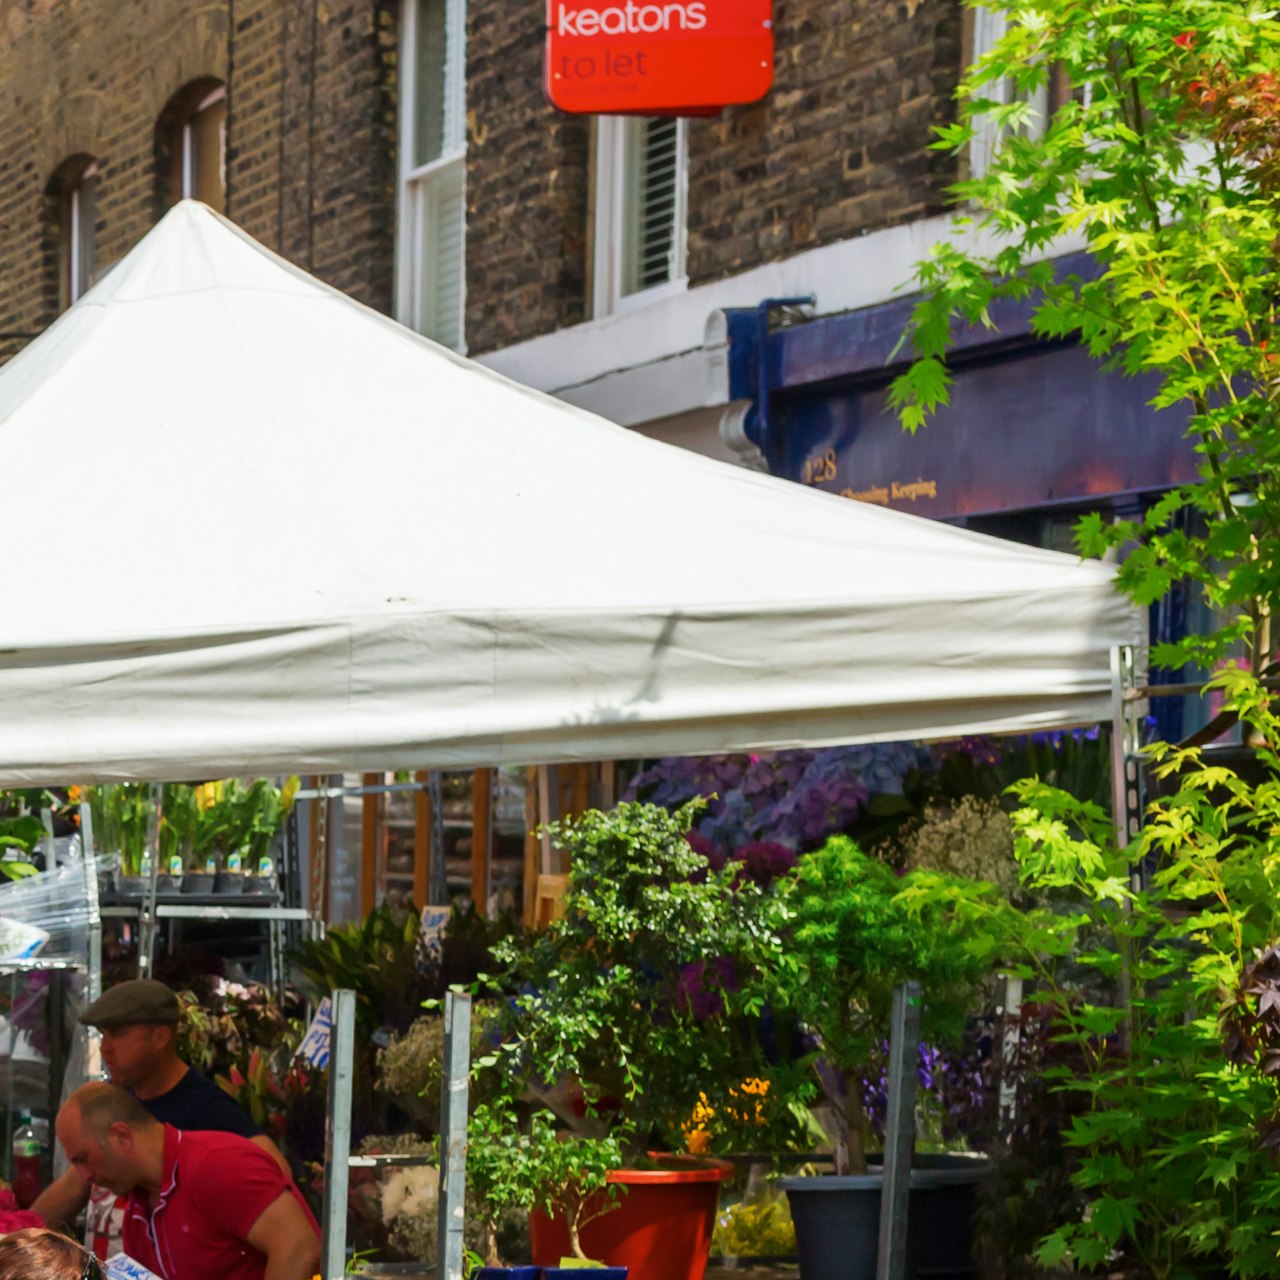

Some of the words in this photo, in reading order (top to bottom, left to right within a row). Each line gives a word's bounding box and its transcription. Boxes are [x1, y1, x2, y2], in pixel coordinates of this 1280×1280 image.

[558, 0, 707, 37] keatons
[561, 54, 597, 79] to
[605, 48, 647, 77] let
